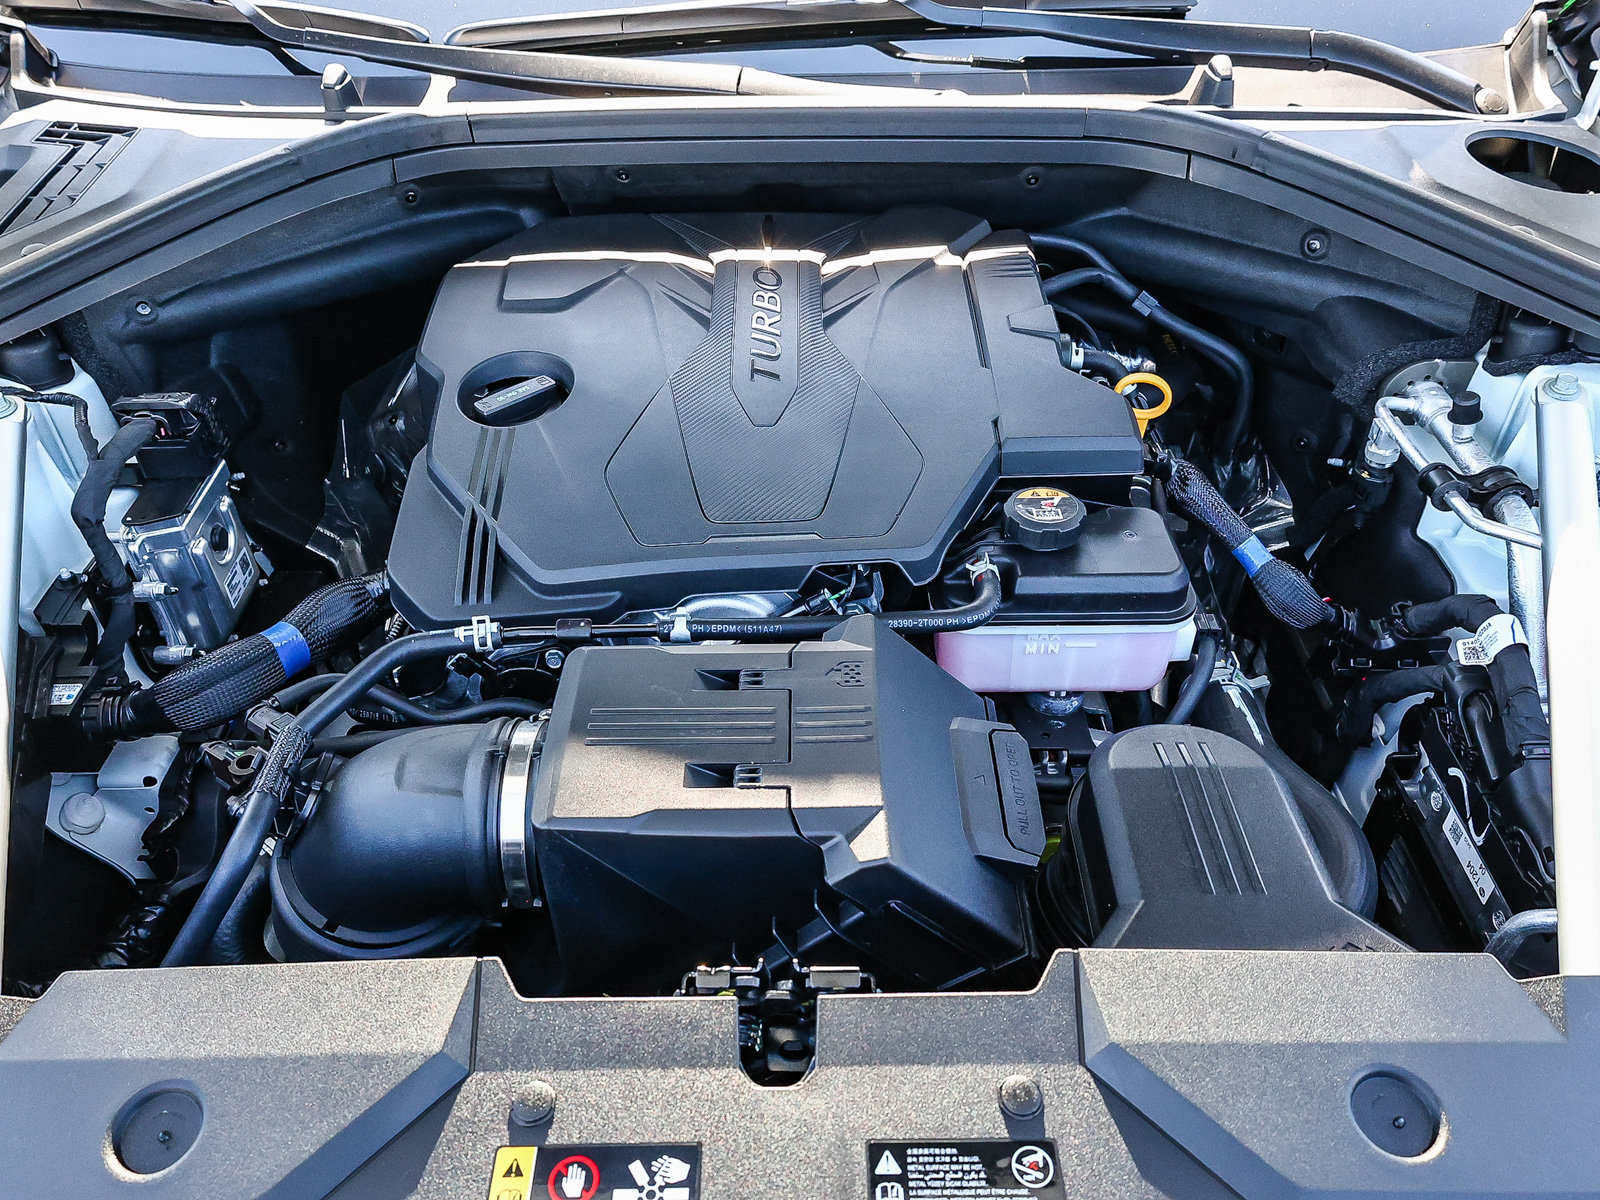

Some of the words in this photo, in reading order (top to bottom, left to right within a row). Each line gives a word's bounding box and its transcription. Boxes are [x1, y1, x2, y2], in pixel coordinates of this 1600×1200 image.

[749, 266, 783, 382] TURBO
[744, 624, 783, 634] (511A47)
[888, 618, 944, 628] 28390-2T000
[946, 618, 959, 626] PH
[1025, 642, 1060, 655] MIN
[1010, 769, 1022, 785] TO
[1012, 785, 1026, 807] OUT
[1017, 809, 1031, 836] PULL
[1466, 860, 1481, 887] T204
